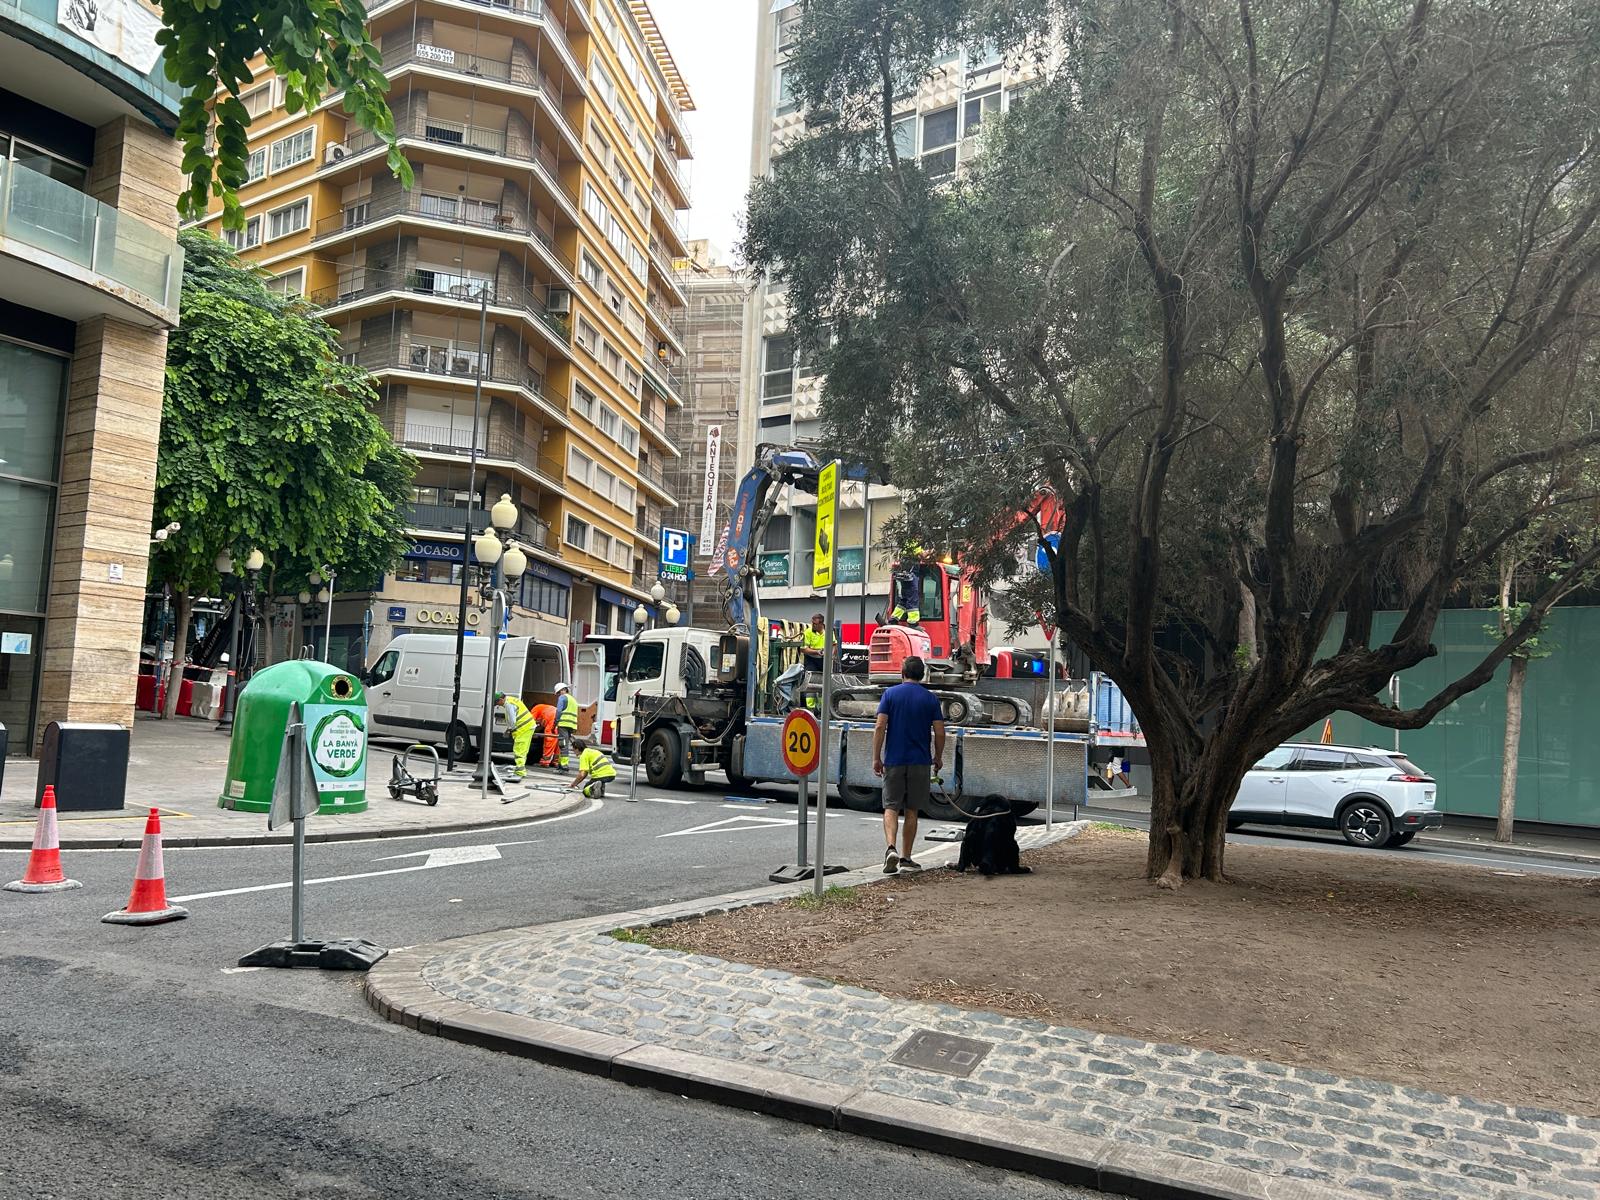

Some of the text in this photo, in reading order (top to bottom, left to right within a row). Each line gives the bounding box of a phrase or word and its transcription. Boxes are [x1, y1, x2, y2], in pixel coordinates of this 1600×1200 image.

[417, 50, 429, 58] 655
[430, 52, 442, 61] 200
[706, 439, 717, 511] ANTEQUERA
[413, 544, 460, 557] OCASO
[668, 533, 683, 560] P
[533, 563, 549, 576] OCASO
[417, 609, 480, 626] OCAO
[323, 740, 334, 748] LA
[789, 731, 811, 753] 20
[327, 749, 356, 758] VERDE
